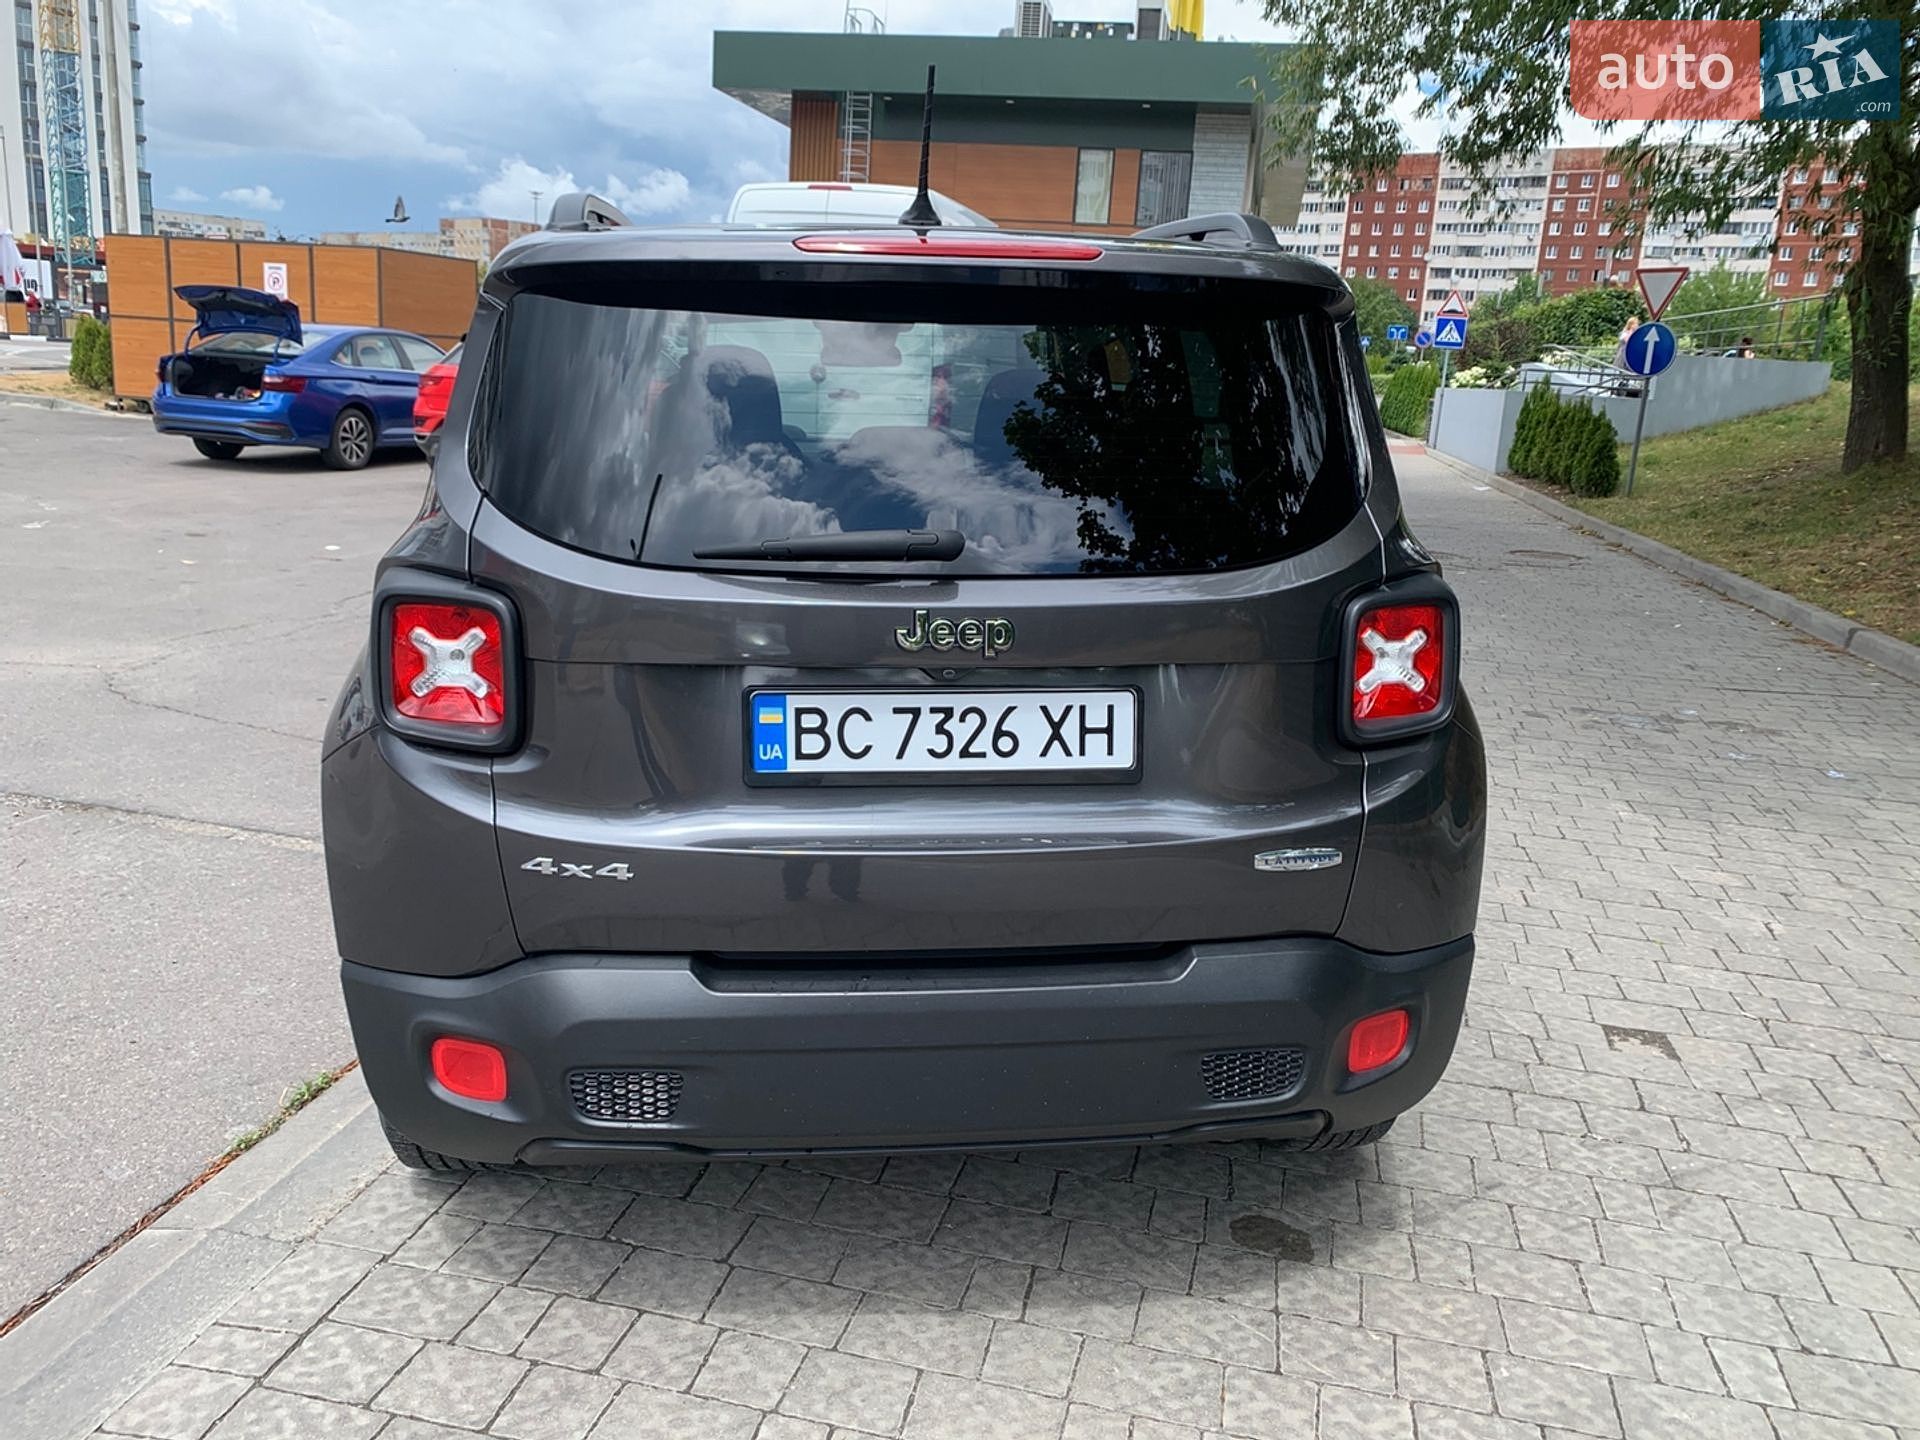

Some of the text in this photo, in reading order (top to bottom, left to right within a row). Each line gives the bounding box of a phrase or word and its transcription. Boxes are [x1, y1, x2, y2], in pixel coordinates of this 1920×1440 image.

[895, 610, 1016, 657] Jeep
[794, 704, 1115, 760] BC 7326 XH
[759, 743, 783, 760] UA
[520, 856, 634, 881] 4x4
